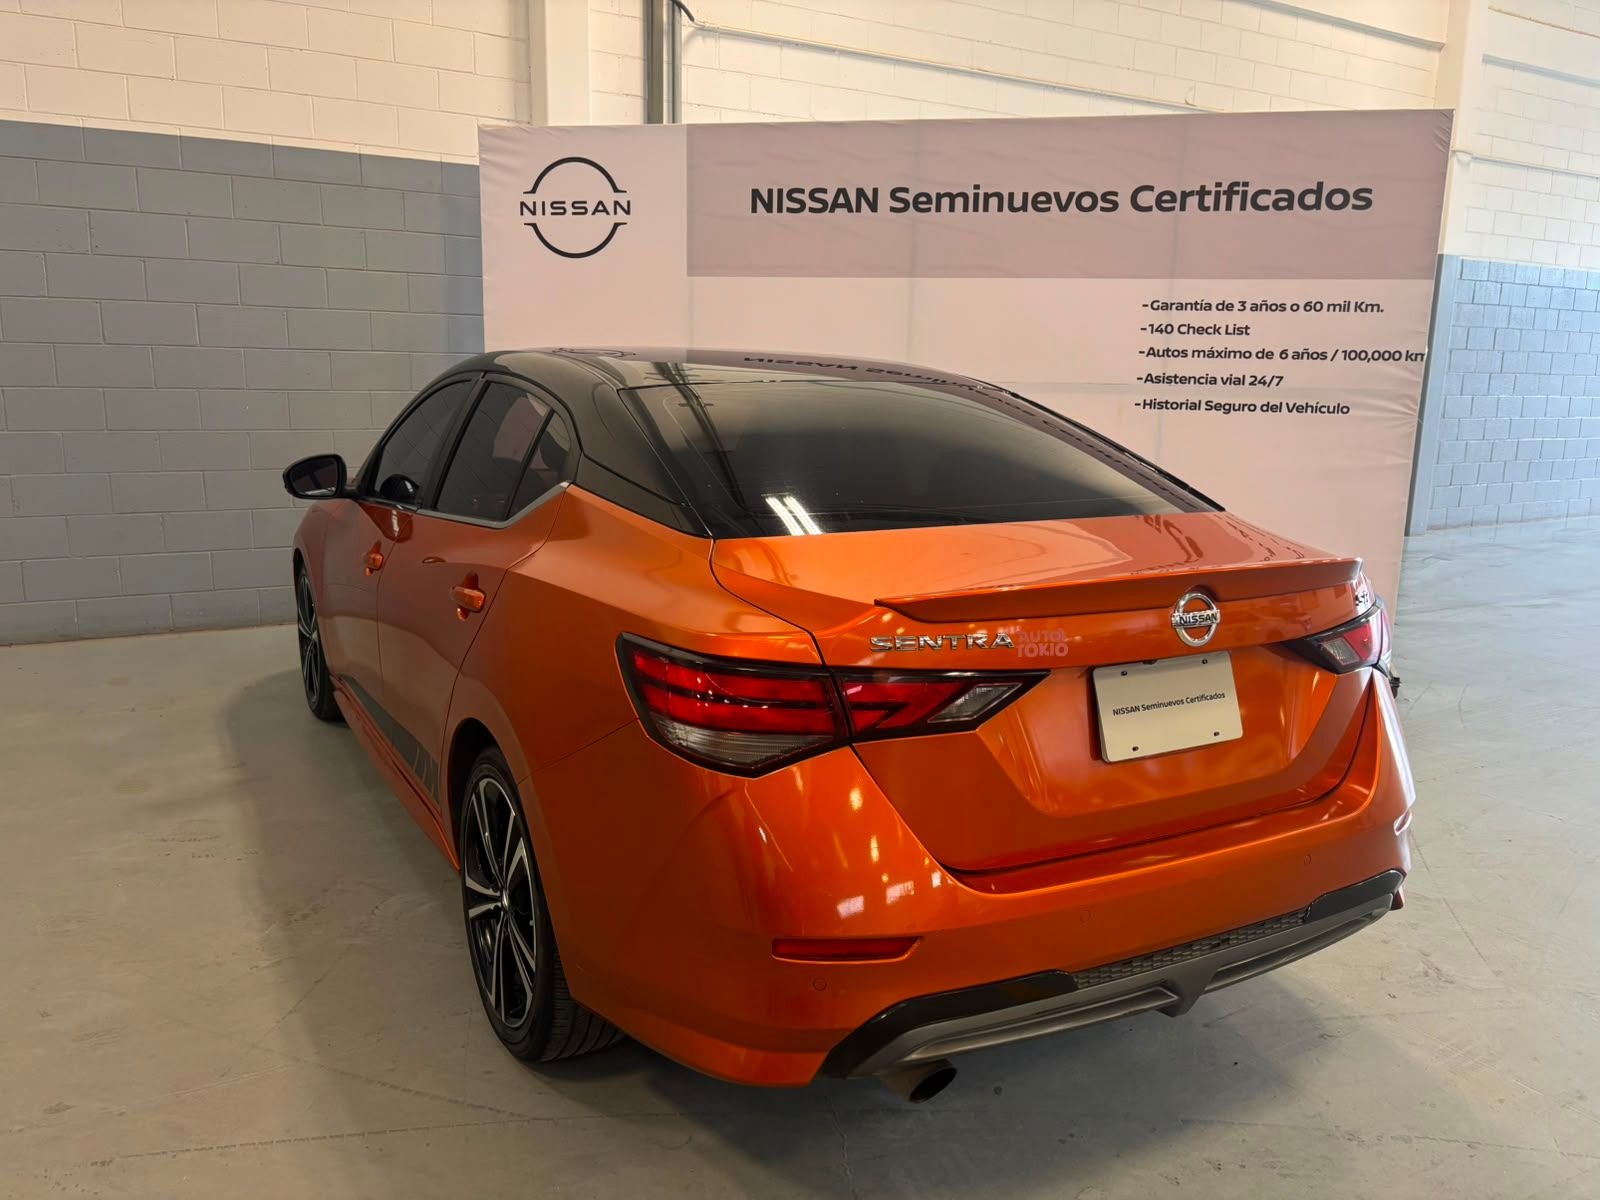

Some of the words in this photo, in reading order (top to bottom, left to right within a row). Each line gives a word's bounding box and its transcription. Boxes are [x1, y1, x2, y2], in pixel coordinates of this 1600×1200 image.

[751, 188, 878, 213] NISSAN
[890, 184, 1119, 213] Seminuevos
[1131, 181, 1372, 212] Certificados
[520, 200, 630, 216] NISSAN
[1142, 299, 1212, 311] -Garantía
[1216, 300, 1234, 311] de
[1238, 301, 1246, 311] 3
[1250, 300, 1286, 312] años
[1290, 303, 1300, 312] o
[1304, 301, 1323, 312] 60
[1327, 301, 1350, 312] mil
[1354, 302, 1384, 312] Km.
[1141, 324, 1174, 334] -140
[1177, 324, 1221, 335] Check
[1225, 324, 1250, 335] List
[1139, 347, 1188, 358] -Autos
[1192, 347, 1252, 359] máximo
[1255, 348, 1274, 359] de
[1279, 349, 1288, 360] 6
[1292, 349, 1327, 360] años
[1330, 349, 1339, 361] /
[1342, 350, 1402, 363] 100,000
[1137, 373, 1217, 385] -Asistencia
[1221, 374, 1245, 385] vial
[1249, 376, 1283, 387] 24/7
[1135, 398, 1201, 410] -Historial
[1205, 401, 1257, 414] Seguro
[1260, 402, 1282, 412] del
[1286, 402, 1350, 414] Vehículo
[1179, 613, 1217, 625] NISSAN
[870, 632, 1015, 651] SENTRA
[1017, 642, 1069, 658] TOKIO
[1112, 705, 1141, 716] NISSAN
[1141, 698, 1185, 712] Seminuevos
[1185, 692, 1226, 705] Certificados
